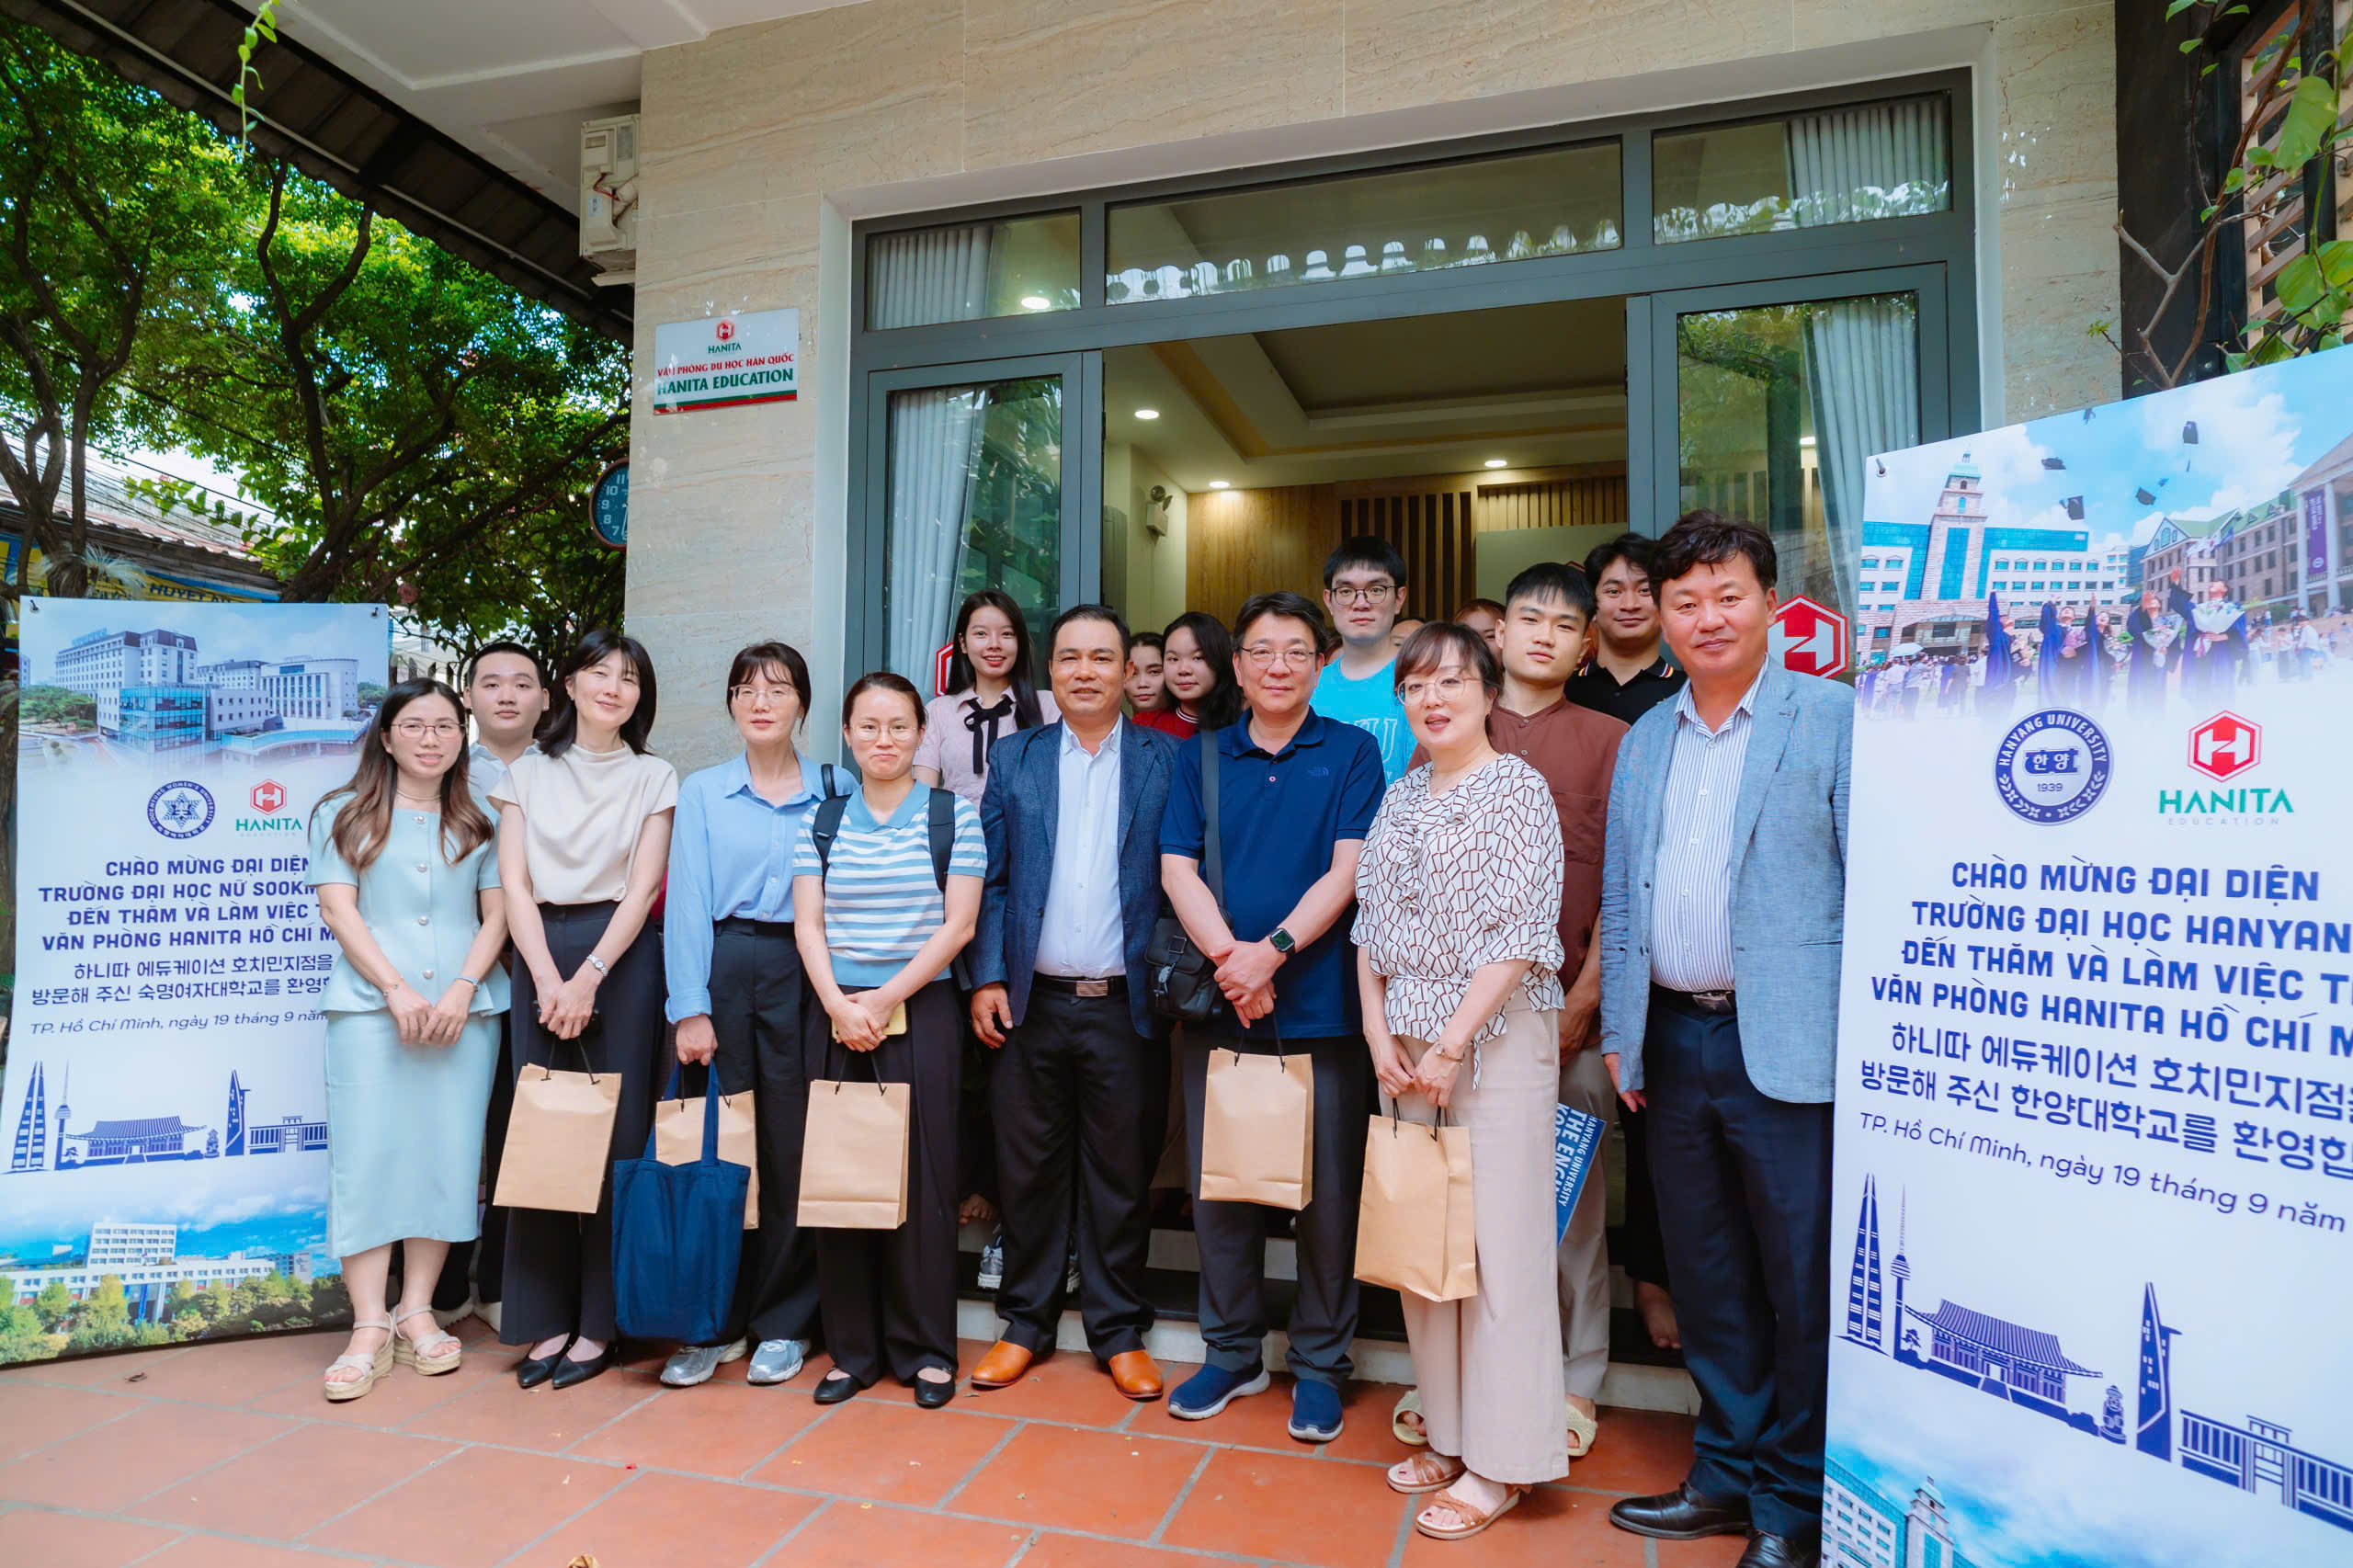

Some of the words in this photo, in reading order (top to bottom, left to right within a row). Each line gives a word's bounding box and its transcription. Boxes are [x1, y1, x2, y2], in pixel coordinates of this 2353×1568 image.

[708, 343, 742, 354] HANITA
[710, 363, 722, 371] DU
[725, 359, 744, 369] HỌC
[746, 356, 766, 368] HÀN
[767, 353, 794, 365] QUỐC
[657, 378, 709, 395] HANITA
[712, 368, 793, 390] EDUCATION
[606, 485, 618, 496] 10
[601, 500, 610, 509] 9
[603, 515, 612, 524] 8
[612, 526, 620, 536] 7
[1998, 717, 2043, 766] HANYANG
[2047, 713, 2108, 761] UNIVERSITY
[2032, 754, 2069, 771] 한양
[2038, 783, 2063, 792] 1939
[2159, 788, 2294, 813] HANITA
[236, 818, 302, 831] HANITA
[106, 856, 159, 876] CHÀO
[167, 855, 224, 875] MỪNG
[231, 858, 263, 876] ĐẠI
[39, 881, 125, 902] TRƯỜNG
[131, 884, 165, 903] ĐẠI
[174, 883, 212, 901] HỌC
[220, 879, 247, 897] NỮ
[1952, 854, 2028, 890] CHÀO
[2040, 855, 2136, 893] MỪNG
[2148, 867, 2209, 903] ĐẠI
[2226, 864, 2319, 906] DIỆN
[66, 905, 109, 926] ĐẾN
[119, 905, 176, 924] THĂM
[185, 902, 210, 922] VÀ
[218, 901, 258, 921] LÀM
[267, 901, 308, 922] VIỆC
[1912, 893, 2026, 932] TRƯỜNG
[2035, 907, 2088, 941] ĐẠI
[2103, 911, 2171, 946] HỌC
[2187, 915, 2352, 953] HANYAN
[42, 932, 85, 950] VĂN
[93, 927, 161, 949] PHÒNG
[169, 929, 241, 947] HANITA
[250, 924, 278, 944] HỒ
[282, 921, 315, 942] CHÍ
[74, 962, 131, 980] 하니따
[137, 958, 225, 978] 에듀케이션
[232, 954, 333, 972] 호치민지점을
[1901, 936, 1956, 968] ĐẾN
[1967, 943, 2053, 978] THĂM
[2067, 944, 2108, 983] VÀ
[2122, 948, 2198, 991] LÀM
[2214, 961, 2303, 1005] VIỆC
[32, 987, 89, 1006] 방문해
[96, 985, 131, 1003] 주신
[138, 979, 280, 1000] 숙명여자대학교를
[30, 1023, 55, 1034] TP.
[60, 1018, 84, 1033] Hồ
[89, 1017, 118, 1031] Chí
[119, 1017, 164, 1030] Minh,
[169, 1015, 209, 1030] ngày
[214, 1014, 229, 1026] 19
[234, 1011, 279, 1026] tháng
[284, 1012, 294, 1022] 9
[1871, 973, 1922, 1006] VĂN
[1933, 977, 2029, 1018] PHÒNG
[2041, 994, 2164, 1035] HANITA
[2180, 1003, 2240, 1042] HỒ
[2245, 1012, 2319, 1052] CHÍ
[1892, 1022, 1972, 1062] 하니따
[1982, 1035, 2137, 1088] 에듀케이션
[2150, 1057, 2353, 1124] 호치민지점
[1861, 1060, 1937, 1101] 방문해
[1947, 1074, 1999, 1112] 주신
[2011, 1085, 2218, 1153] 한양대학교를
[1562, 1108, 1588, 1143] THE
[1576, 1115, 1597, 1155] HANYANG
[1558, 1156, 1584, 1207] UNIVERSITY
[1860, 1112, 1888, 1133] TP.
[1893, 1119, 1923, 1140] Hồ
[1928, 1127, 1967, 1150] Chí
[1969, 1135, 2031, 1167] Minh,
[2040, 1154, 2104, 1186] ngày
[2113, 1165, 2140, 1187] 19
[2150, 1172, 2237, 1214] tháng
[2247, 1193, 2268, 1214] 9
[2278, 1201, 2346, 1233] năm
